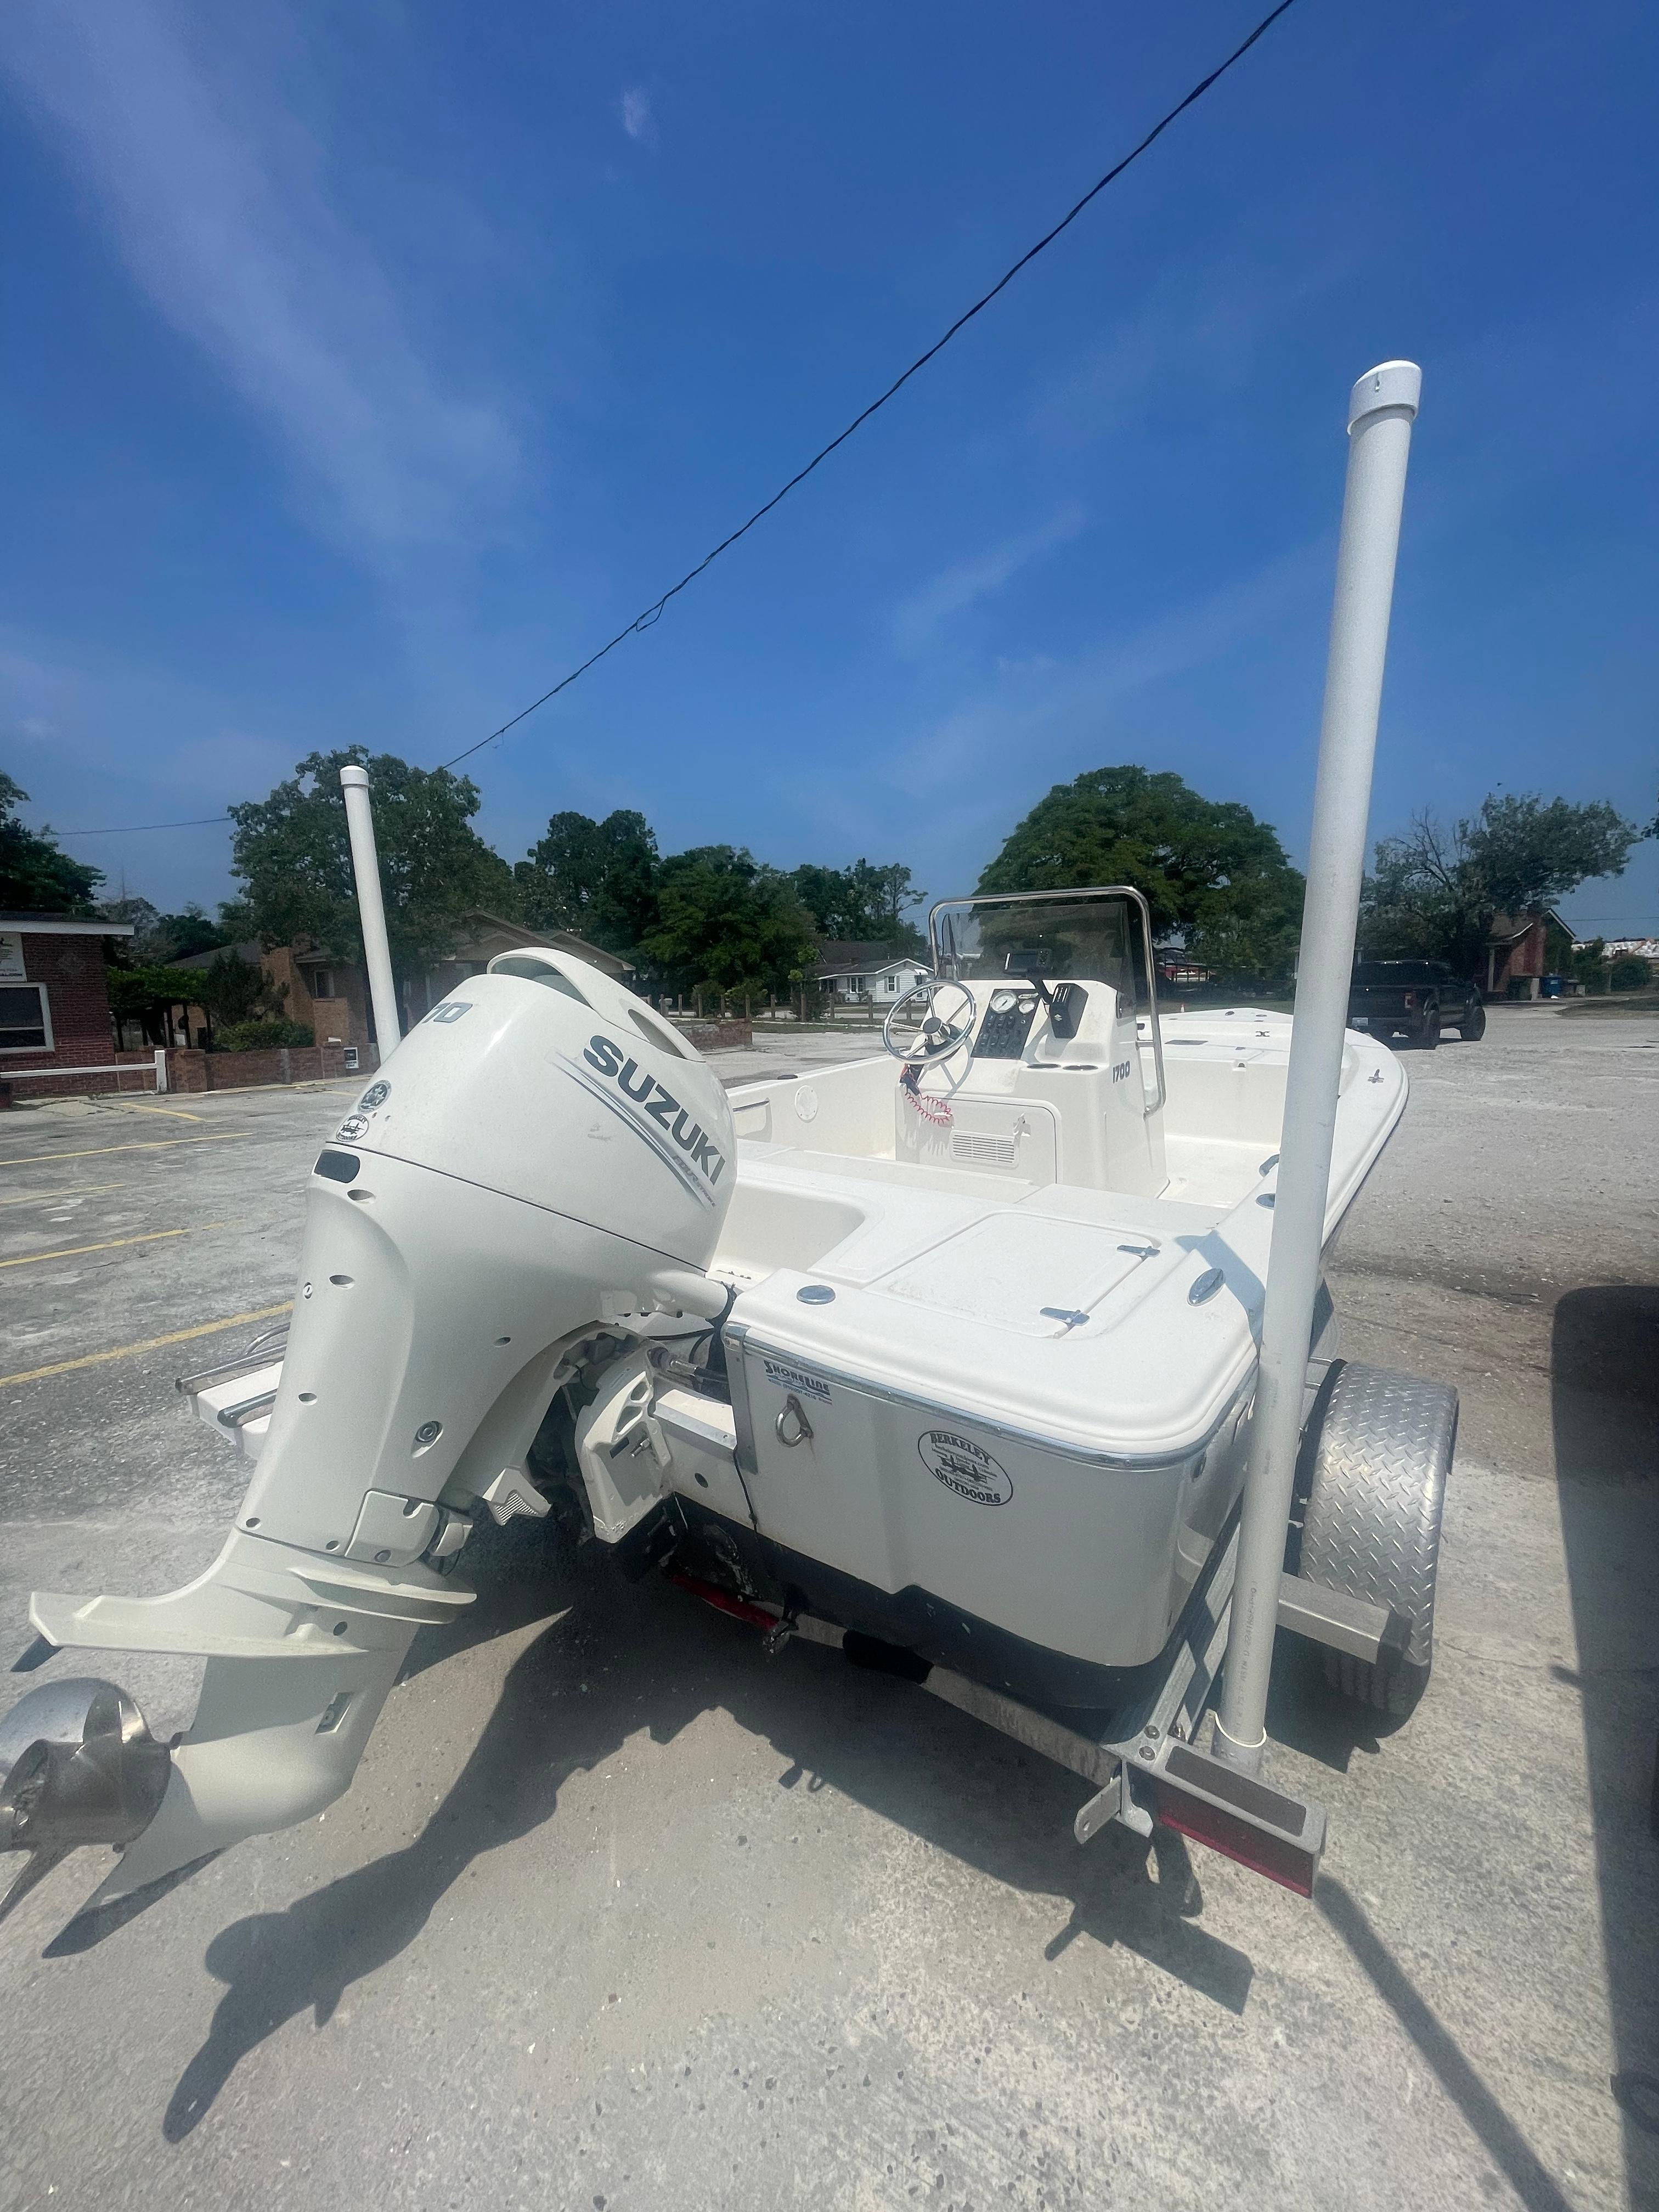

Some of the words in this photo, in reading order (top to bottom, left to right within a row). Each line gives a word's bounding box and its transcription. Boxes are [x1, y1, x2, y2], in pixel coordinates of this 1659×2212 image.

[1113, 1060, 1130, 1084] 1700
[583, 1035, 726, 1186] SUZUKI
[929, 1432, 991, 1465] BERKELEY
[935, 1468, 1001, 1504] OUTDOORS
